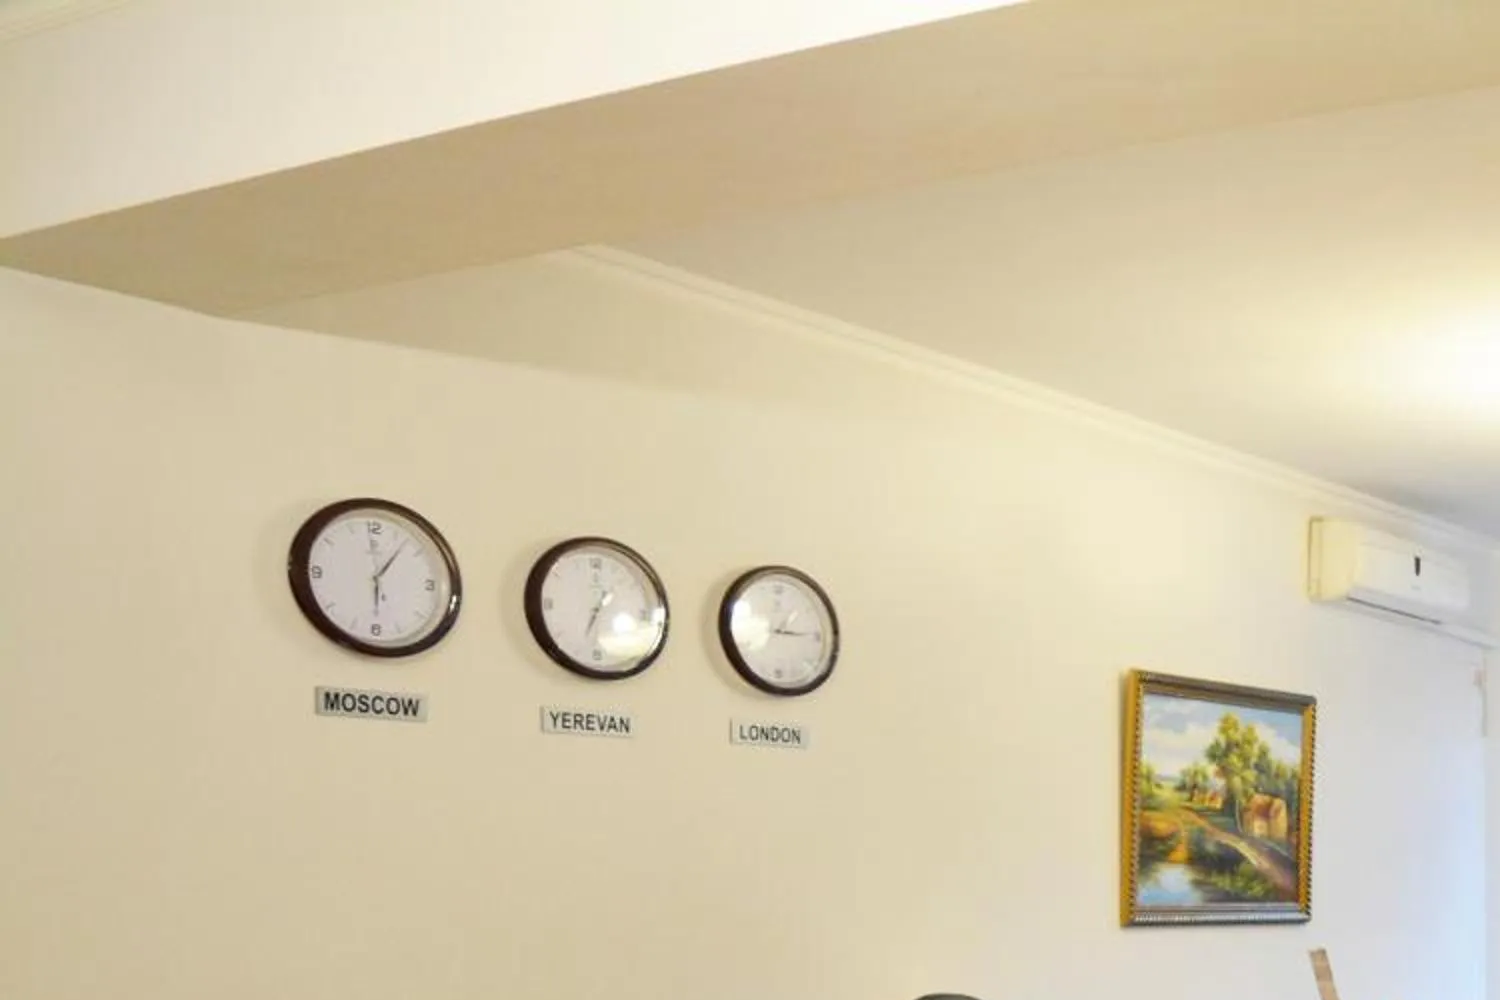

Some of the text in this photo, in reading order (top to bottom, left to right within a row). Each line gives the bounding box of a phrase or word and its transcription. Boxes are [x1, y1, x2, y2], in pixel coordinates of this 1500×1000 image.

[367, 520, 383, 535] 12
[425, 579, 435, 591] 3
[370, 624, 382, 636] 6
[324, 691, 419, 717] MOSCOW
[549, 711, 631, 733] YEREVAN
[739, 725, 801, 744] LONDON
